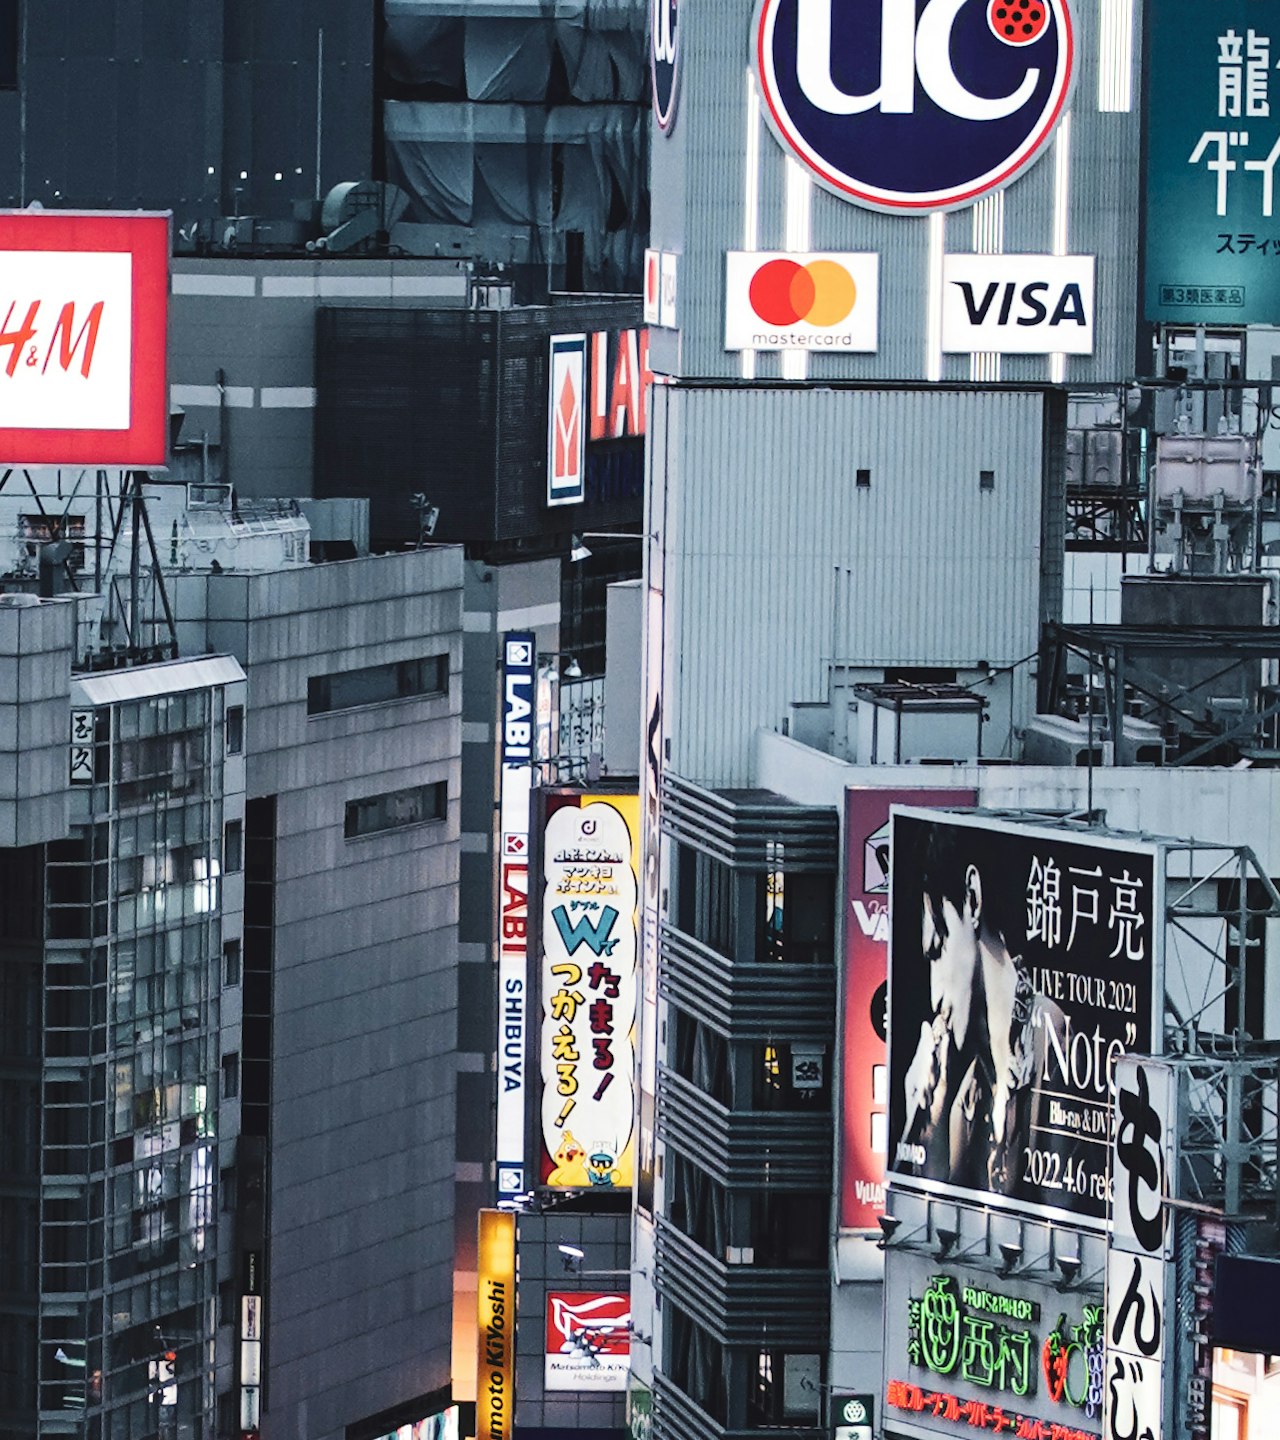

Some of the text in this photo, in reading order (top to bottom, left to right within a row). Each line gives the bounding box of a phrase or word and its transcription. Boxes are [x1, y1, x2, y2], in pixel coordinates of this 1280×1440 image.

[950, 280, 1088, 327] VISA
[1161, 287, 1245, 307] 第3類医薬品
[752, 330, 853, 348] mastercard
[504, 674, 532, 759] LABI
[562, 865, 614, 880] マツキヨ
[502, 863, 528, 953] LABI
[1025, 854, 1146, 961] 錦戸亮
[1032, 967, 1138, 1015] LIVE TOUR 2021
[504, 978, 523, 1094] SHIBUYA
[894, 1142, 926, 1166] NOMAD
[486, 1280, 507, 1369] KiYoshi
[961, 1314, 1032, 1397] 西村
